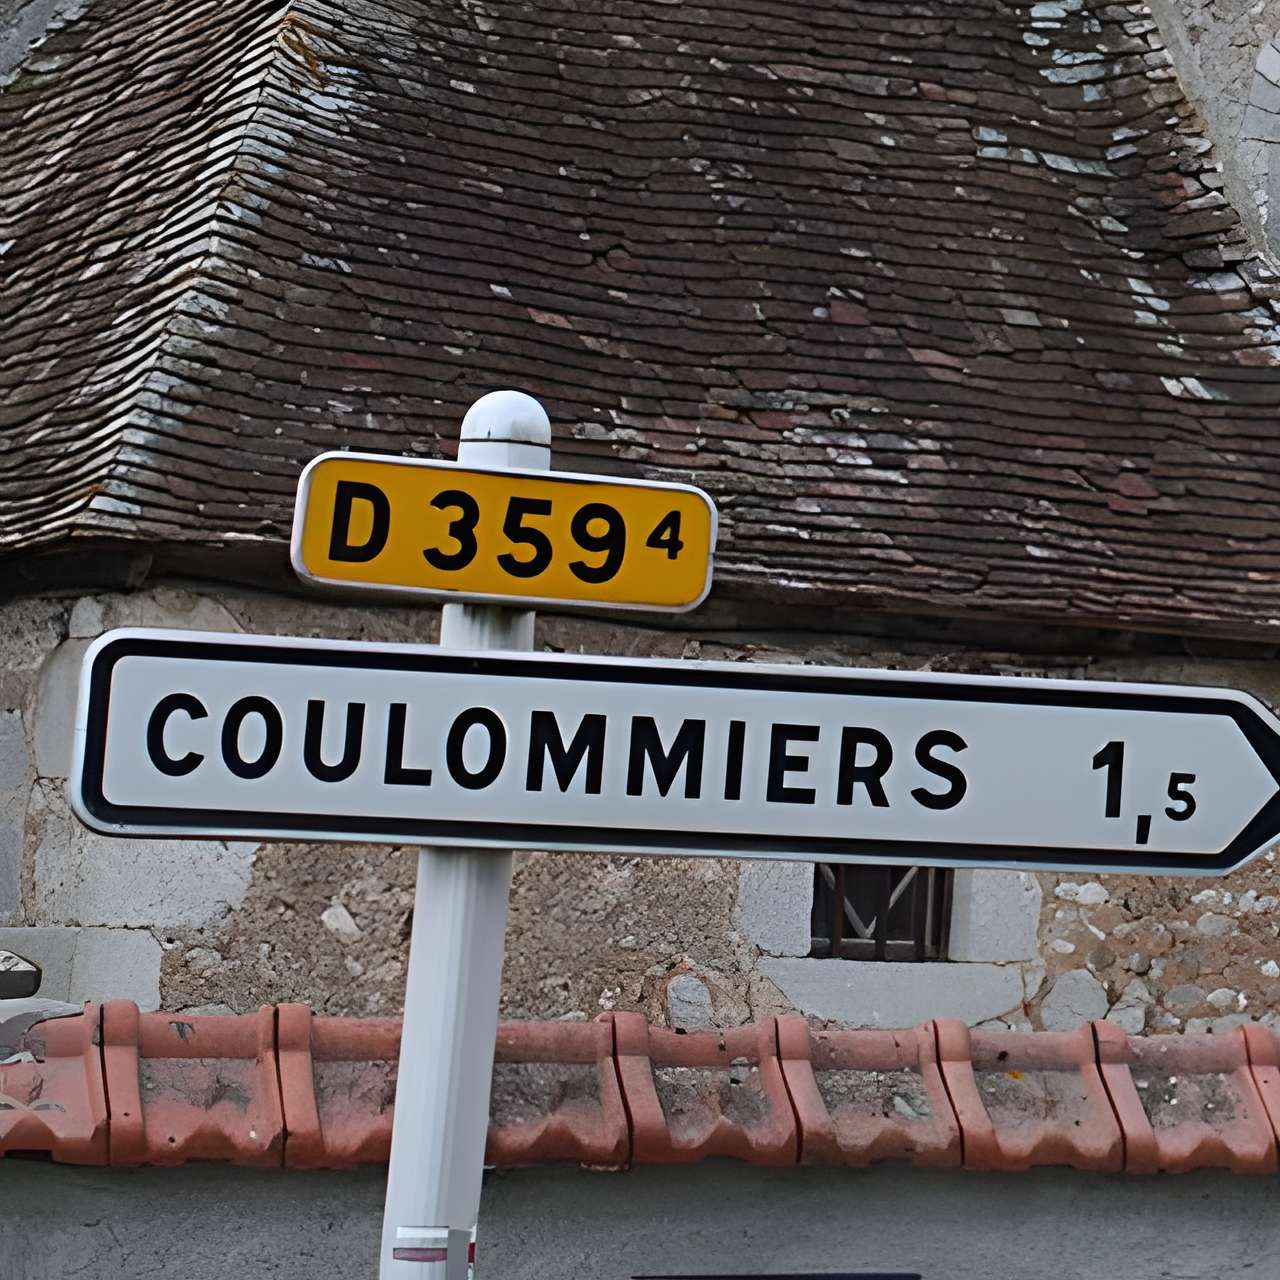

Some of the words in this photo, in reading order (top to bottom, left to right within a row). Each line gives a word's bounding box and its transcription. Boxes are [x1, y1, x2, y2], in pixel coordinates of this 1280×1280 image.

[328, 480, 391, 563] D
[146, 692, 968, 810] COULOMMIERS
[1092, 740, 1197, 845] 1,5
